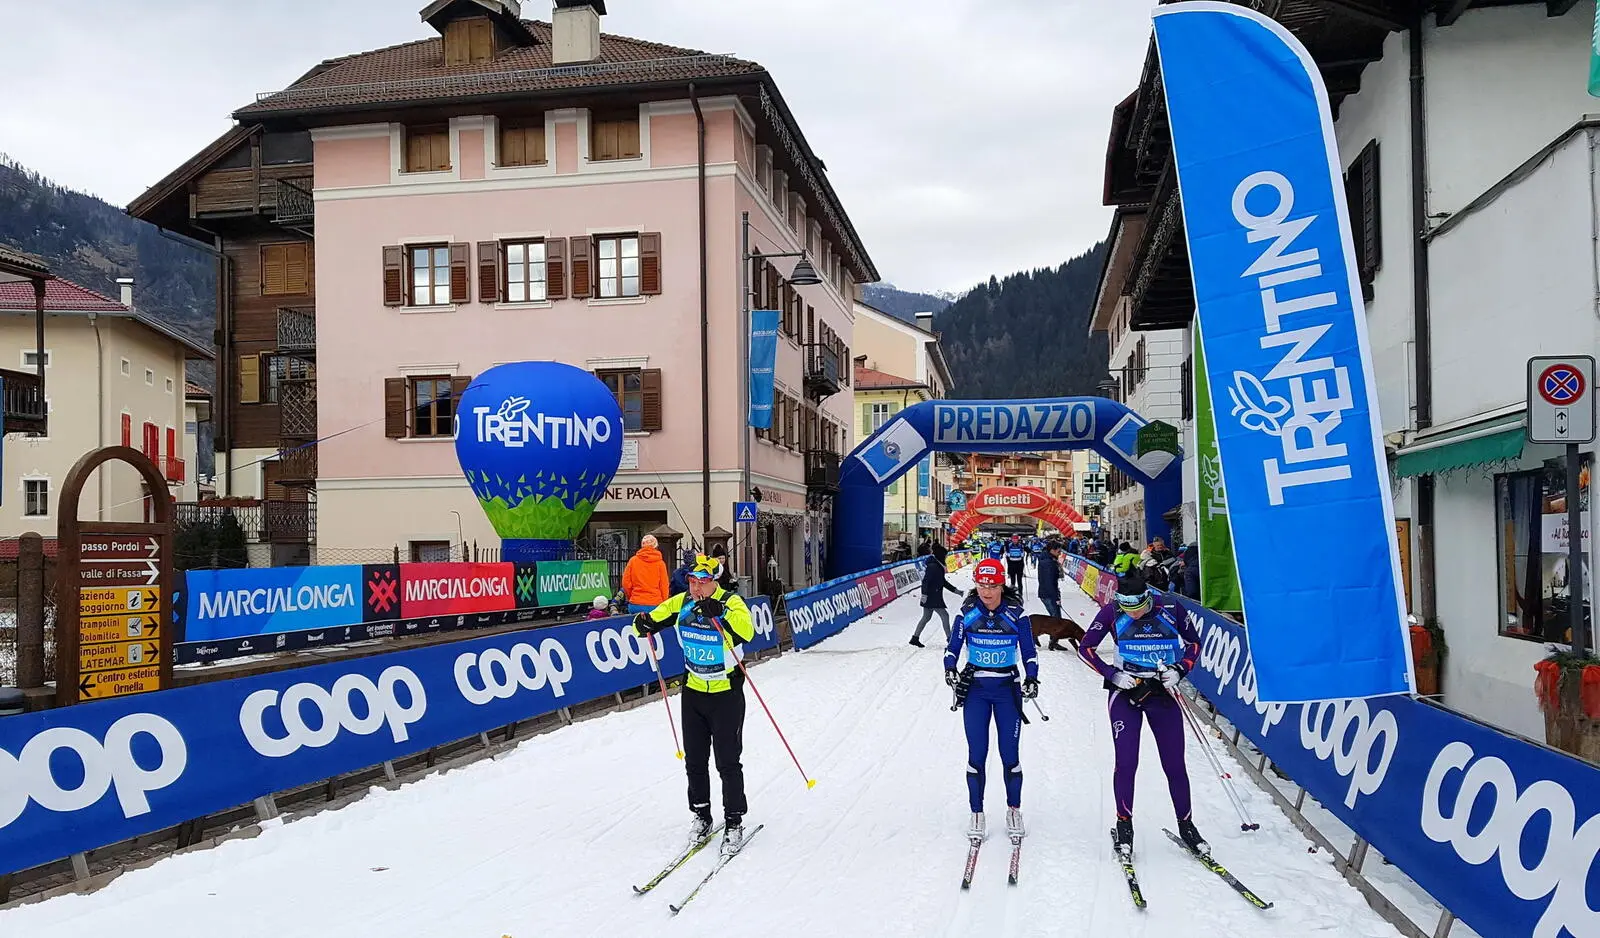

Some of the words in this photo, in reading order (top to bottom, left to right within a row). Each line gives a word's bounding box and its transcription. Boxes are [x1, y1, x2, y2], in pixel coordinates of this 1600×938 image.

[1231, 170, 1354, 506] TRENTINO
[473, 406, 611, 449] TRENTINO
[938, 403, 1092, 440] PREDAZZO
[600, 487, 622, 500] NE
[626, 486, 671, 500] PAOLA
[983, 494, 1031, 505] felicetti
[81, 543, 108, 552] passo
[112, 541, 140, 551] Pordoi
[80, 569, 103, 578] valle
[106, 568, 115, 578] di
[117, 568, 142, 578] Fassa
[405, 576, 510, 602] MARCIALONGA
[540, 571, 607, 593] MARCIALONGA
[80, 591, 115, 600] azienda
[198, 583, 355, 619] MARCIALONGA
[80, 602, 125, 613] soggiorno
[789, 605, 814, 635] coop
[813, 597, 835, 624] coop
[832, 591, 850, 616] coop
[80, 618, 120, 630] trampolini
[80, 632, 120, 642] Dolomitica
[971, 636, 1012, 645] TRENTINGRANA
[80, 645, 117, 657] impianti
[684, 645, 715, 661] 3124
[975, 650, 1007, 665] 3802
[80, 657, 125, 670] LATEMAR
[1201, 623, 1240, 695] coop
[97, 672, 126, 683] Centro
[128, 668, 160, 679] estetico
[113, 682, 144, 694] Ornella
[239, 665, 427, 757] coop
[454, 638, 573, 705] coop
[585, 625, 664, 673] coop
